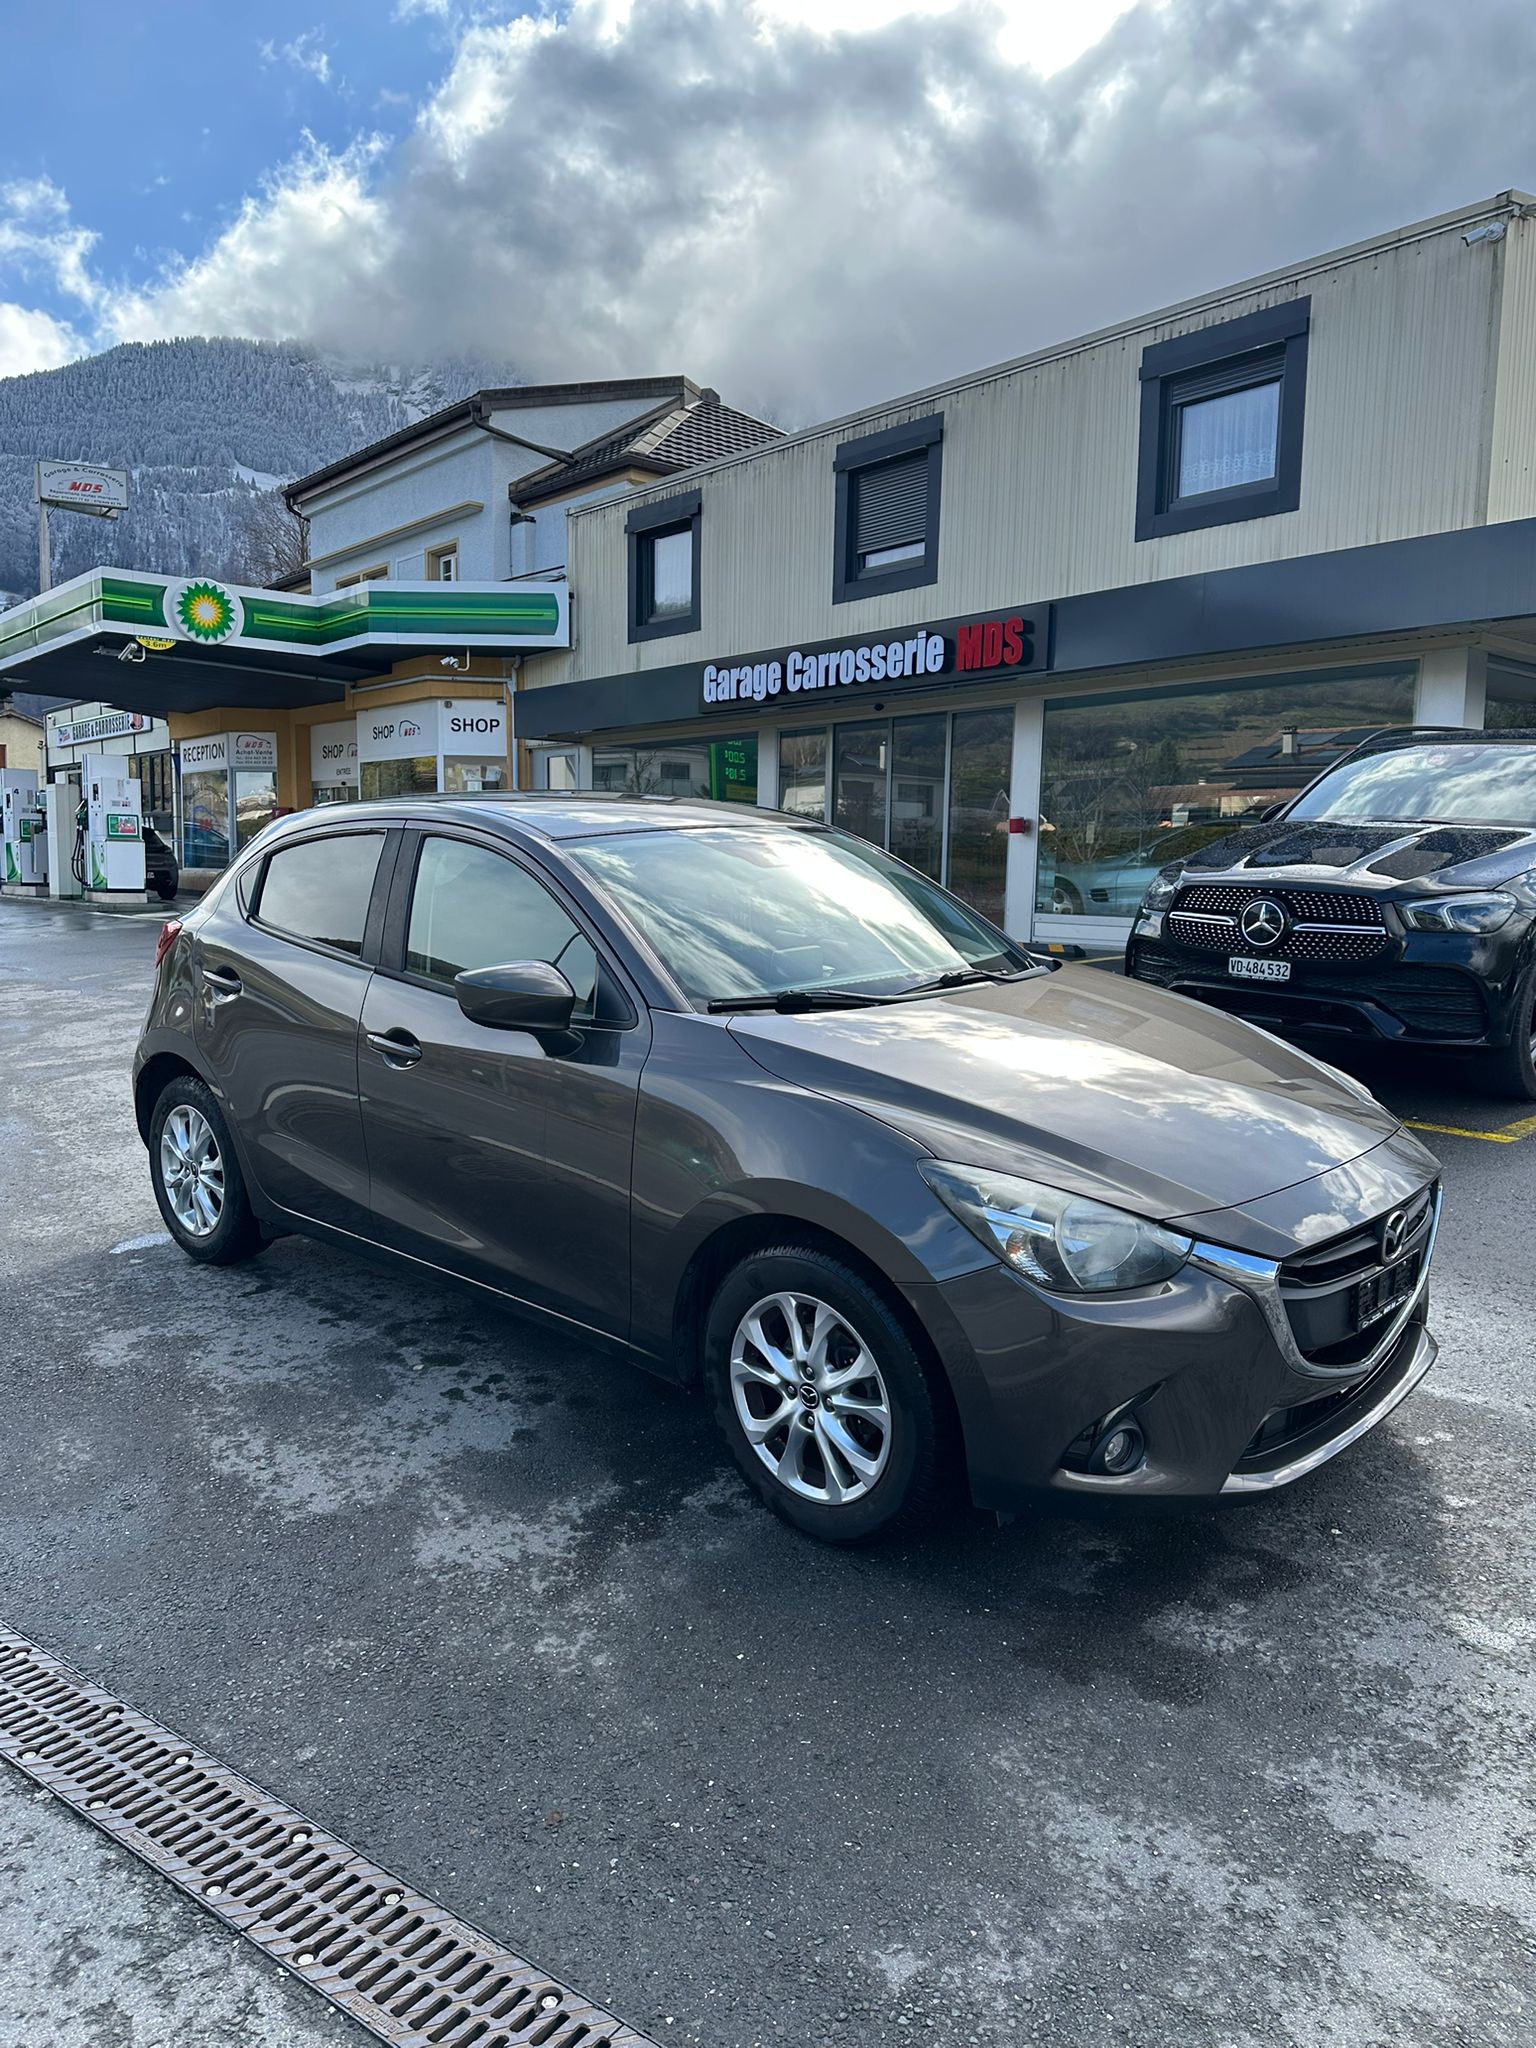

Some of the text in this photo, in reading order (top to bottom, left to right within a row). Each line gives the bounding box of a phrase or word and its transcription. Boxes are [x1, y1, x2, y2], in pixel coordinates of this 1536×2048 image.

[68, 481, 103, 493] MDS
[703, 618, 1024, 703] Garage Carrosserie MDS
[72, 723, 91, 741] GARAGE
[95, 714, 131, 737] CARROSSERIE
[372, 724, 395, 740] SHOP
[451, 718, 500, 733] SHOP
[183, 743, 225, 763] RECEPTION
[322, 744, 344, 759] SHOP
